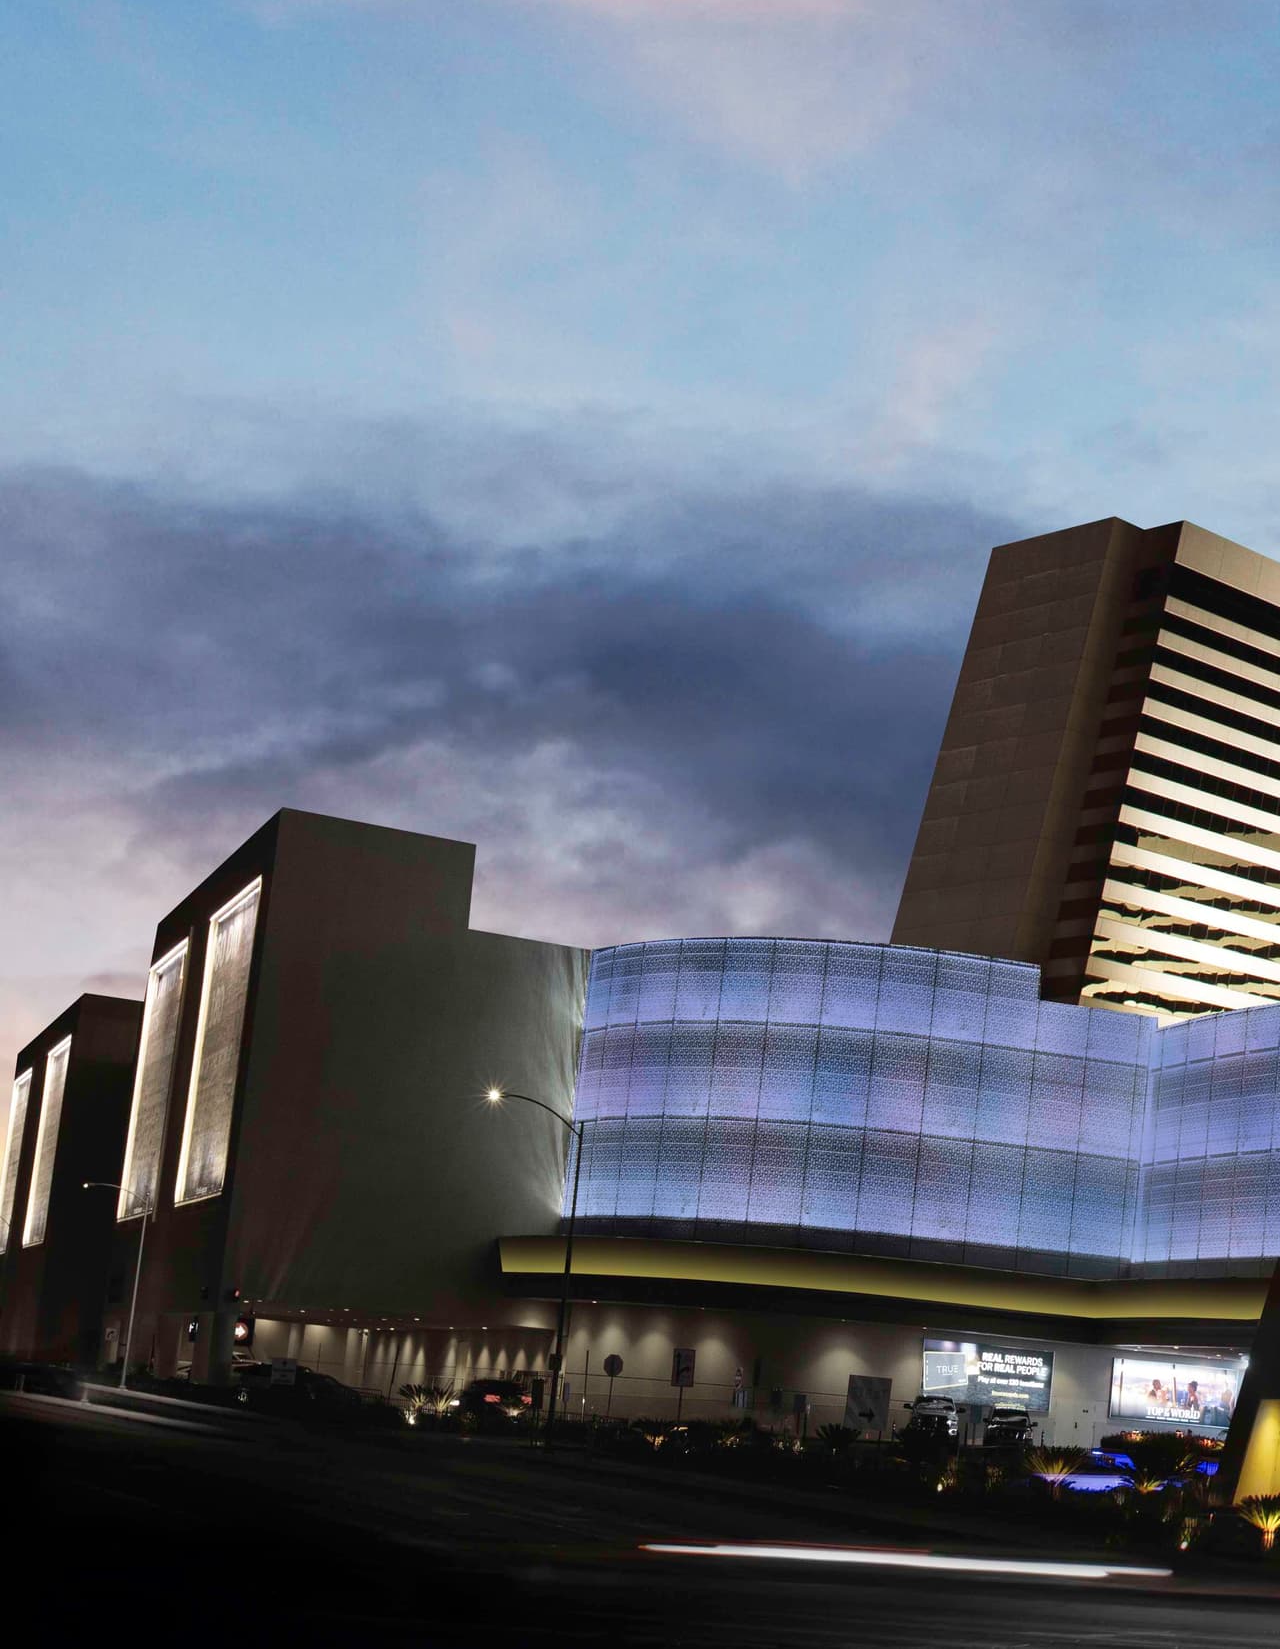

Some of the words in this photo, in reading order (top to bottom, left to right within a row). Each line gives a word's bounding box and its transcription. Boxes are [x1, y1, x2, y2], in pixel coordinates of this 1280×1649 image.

[982, 1353, 1003, 1363] REAL
[1004, 1355, 1043, 1366] REWARDS
[936, 1365, 959, 1374] TRUE
[977, 1361, 993, 1372] FOR
[994, 1363, 1015, 1374] REAL
[1016, 1366, 1048, 1377] PEOPLE
[1146, 1407, 1163, 1416] TOP
[1170, 1405, 1200, 1419] WORLD
